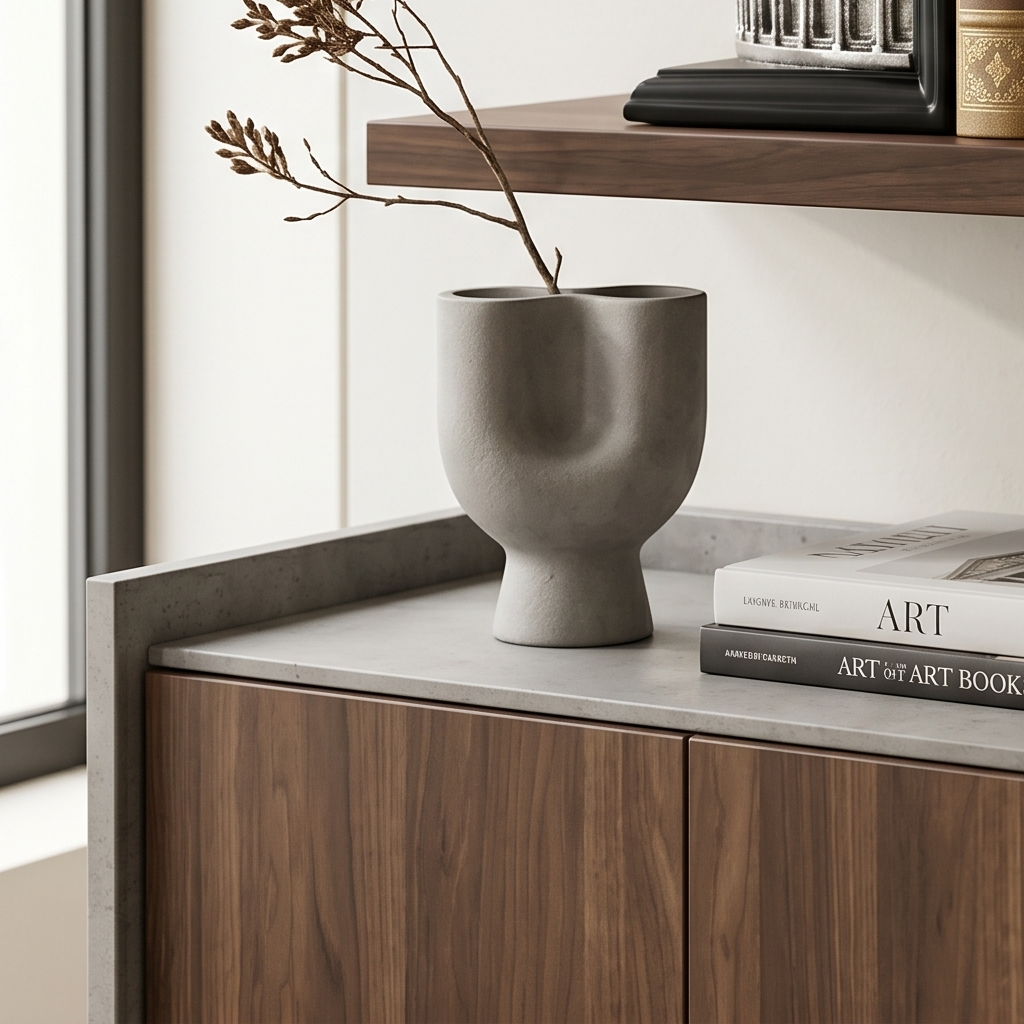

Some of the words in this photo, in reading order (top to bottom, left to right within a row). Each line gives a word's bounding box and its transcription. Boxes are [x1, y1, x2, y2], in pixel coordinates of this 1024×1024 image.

[876, 598, 950, 636] ART
[837, 656, 881, 679] ART
[908, 664, 953, 687] ART
